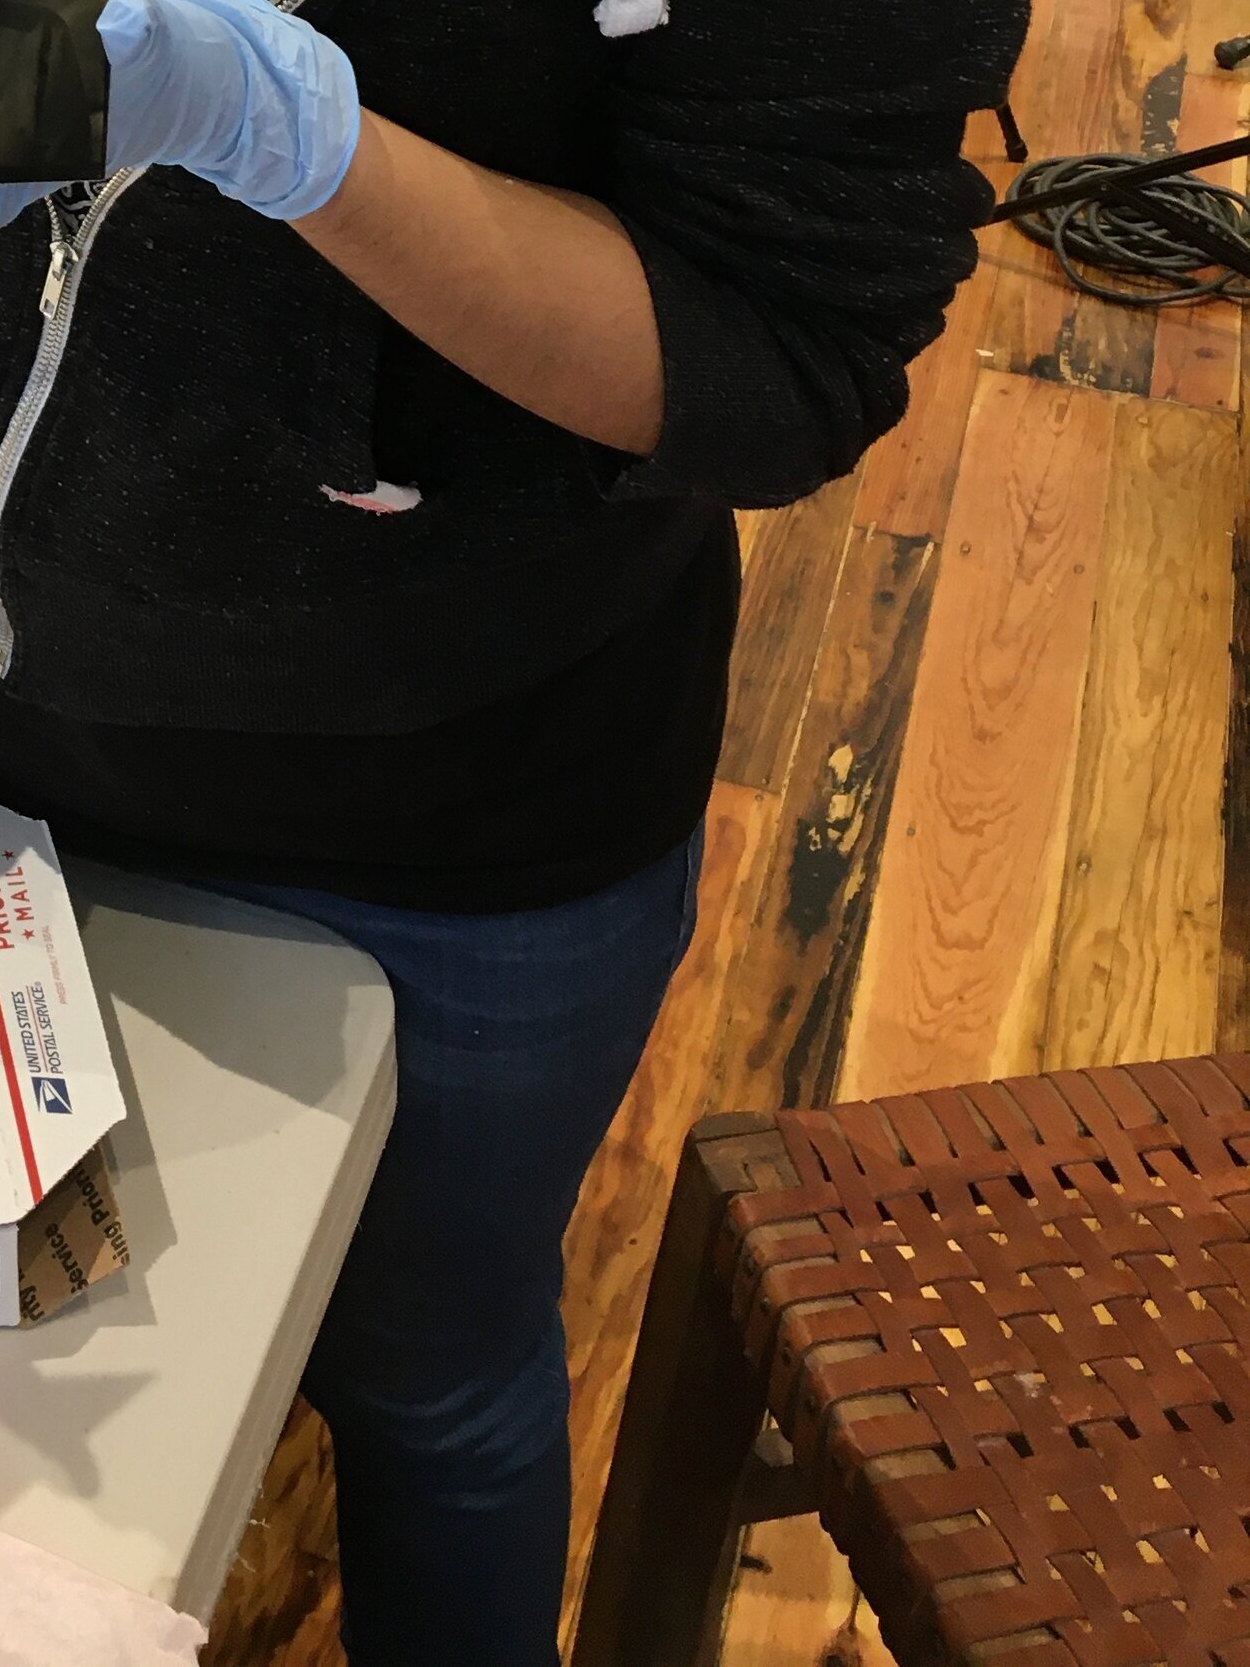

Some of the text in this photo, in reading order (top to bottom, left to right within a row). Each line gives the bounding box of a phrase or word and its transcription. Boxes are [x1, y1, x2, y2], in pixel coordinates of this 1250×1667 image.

[4, 866, 33, 921] MAIL
[12, 991, 40, 1072] UNITED STATES
[42, 1031, 62, 1074] POSTAL
